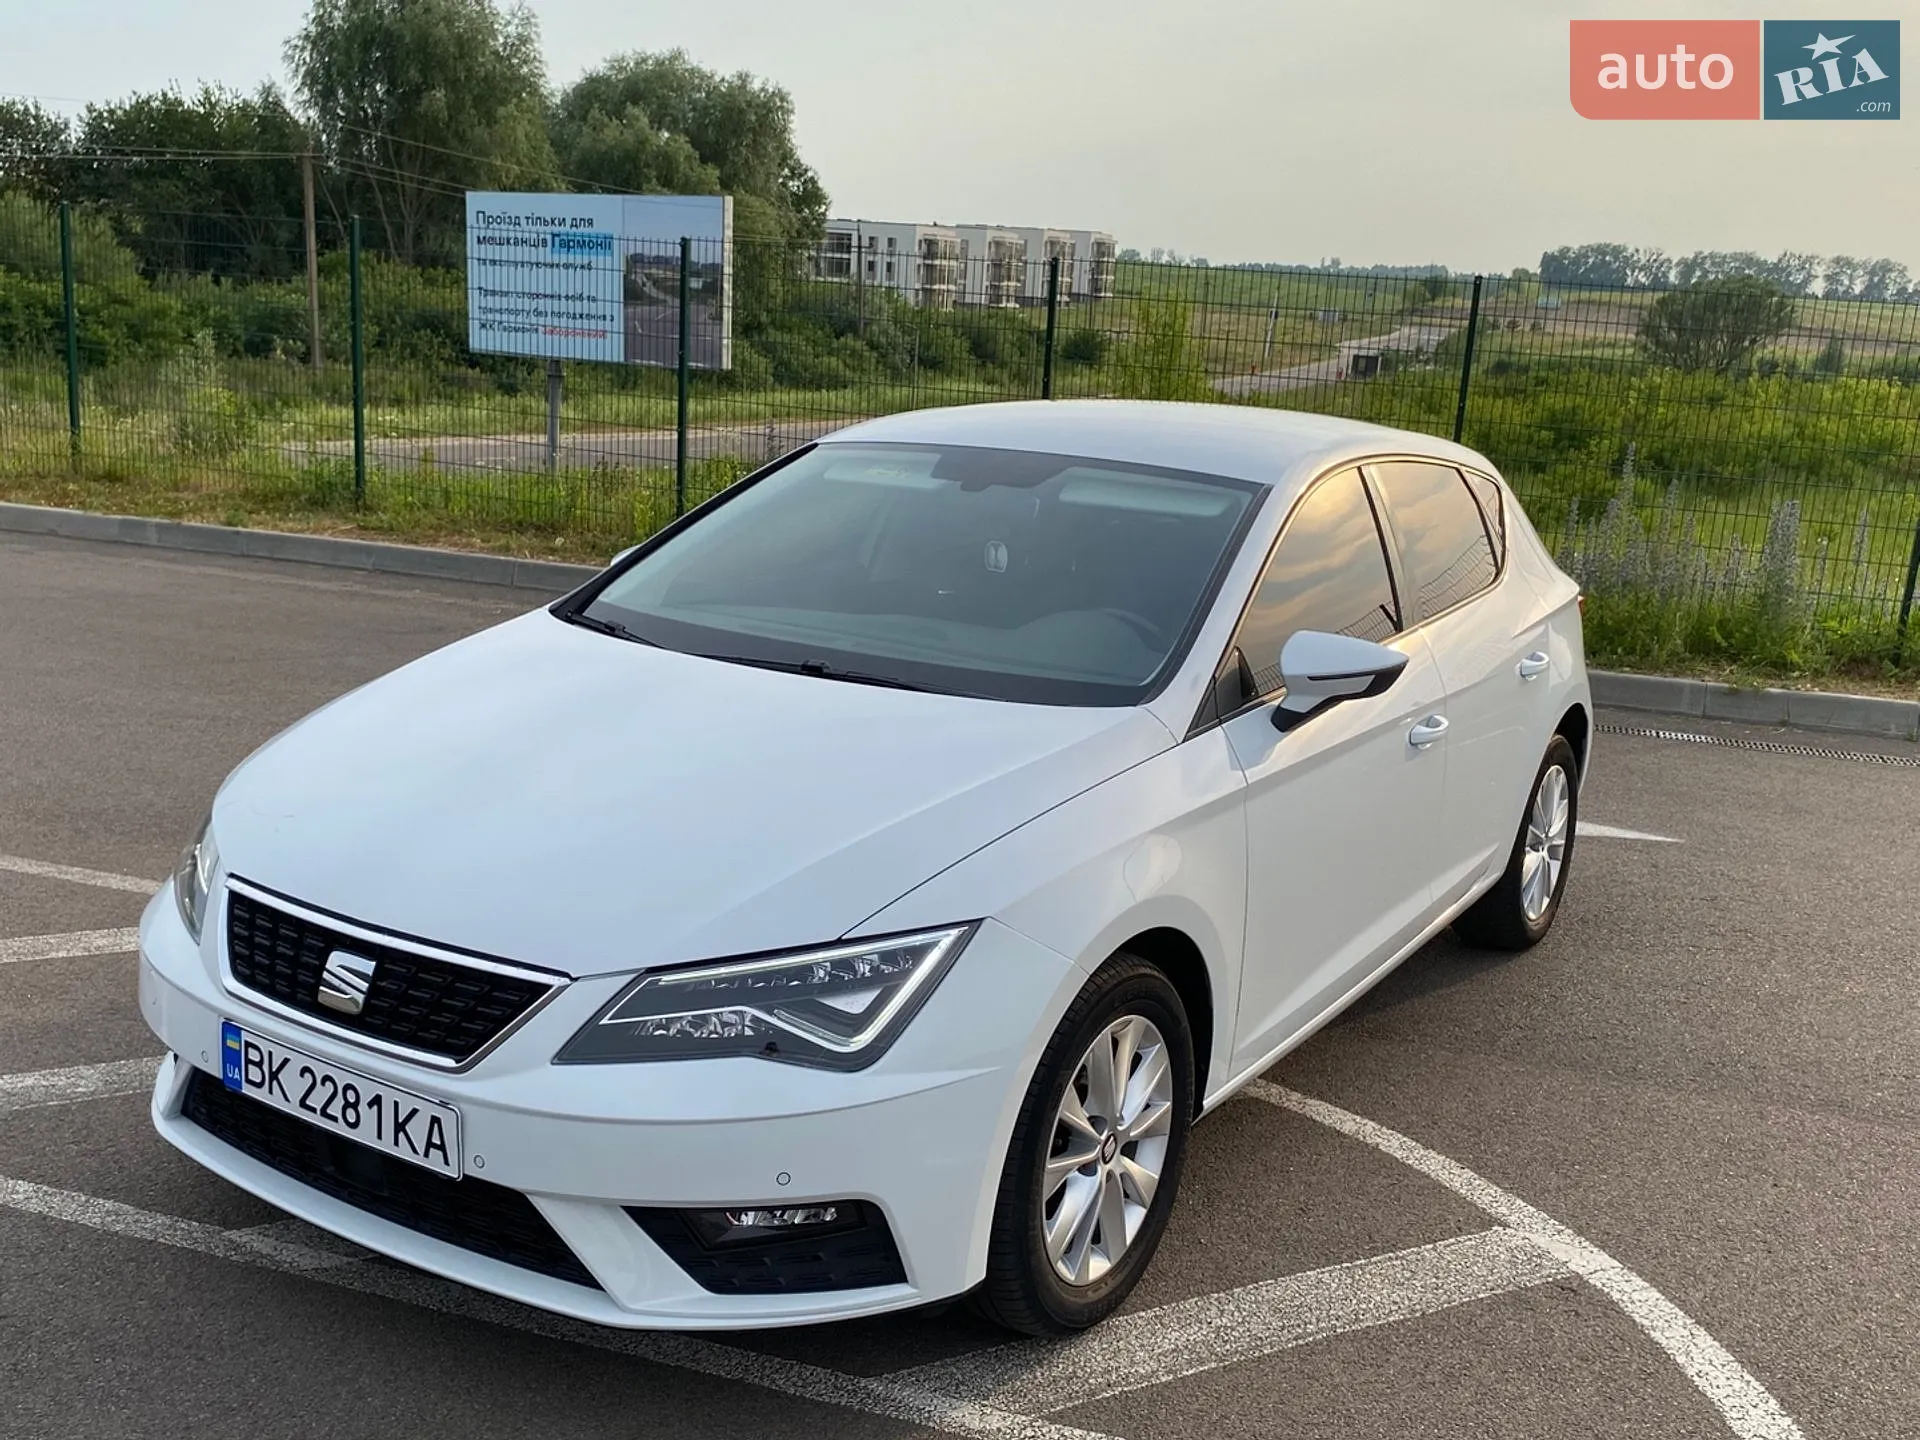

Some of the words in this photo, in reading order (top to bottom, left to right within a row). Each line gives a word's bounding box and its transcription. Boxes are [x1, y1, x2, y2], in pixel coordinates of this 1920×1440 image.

[476, 211, 521, 228] Проїзд
[525, 212, 566, 228] тільки
[569, 218, 594, 229] для
[477, 232, 548, 249] мешканців
[551, 233, 612, 252] Гармонії
[532, 307, 548, 318] без
[226, 1063, 241, 1081] UA
